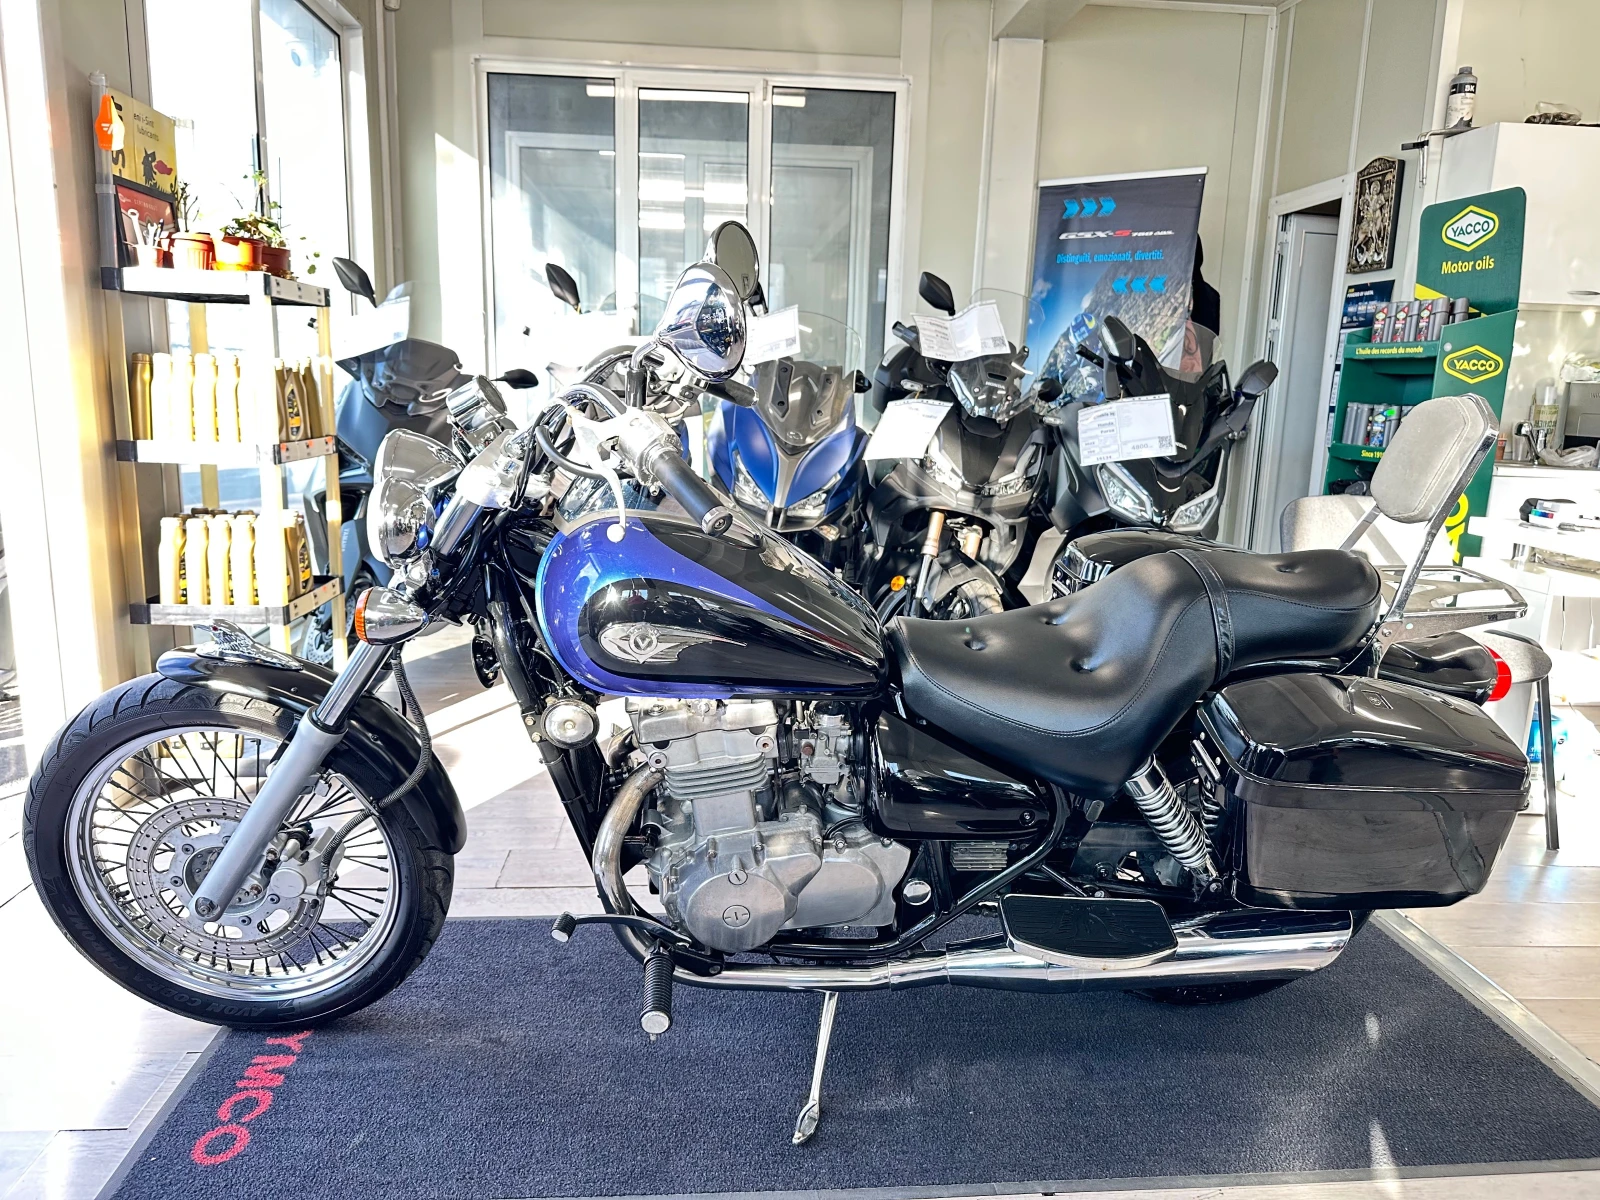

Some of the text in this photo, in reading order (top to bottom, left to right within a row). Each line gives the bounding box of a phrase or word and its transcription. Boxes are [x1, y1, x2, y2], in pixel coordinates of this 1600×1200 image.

[1451, 220, 1490, 238] YACCO
[1056, 249, 1164, 265] Distinguiti, emozionati, divertiti.
[1441, 255, 1495, 275] Motor oils
[1370, 347, 1380, 355] des
[1380, 345, 1397, 354] records
[1398, 345, 1405, 354] du
[1405, 345, 1424, 353] monde
[1453, 359, 1496, 371] YACCO
[1361, 449, 1373, 458] Since
[205, 1001, 267, 1018] AVON
